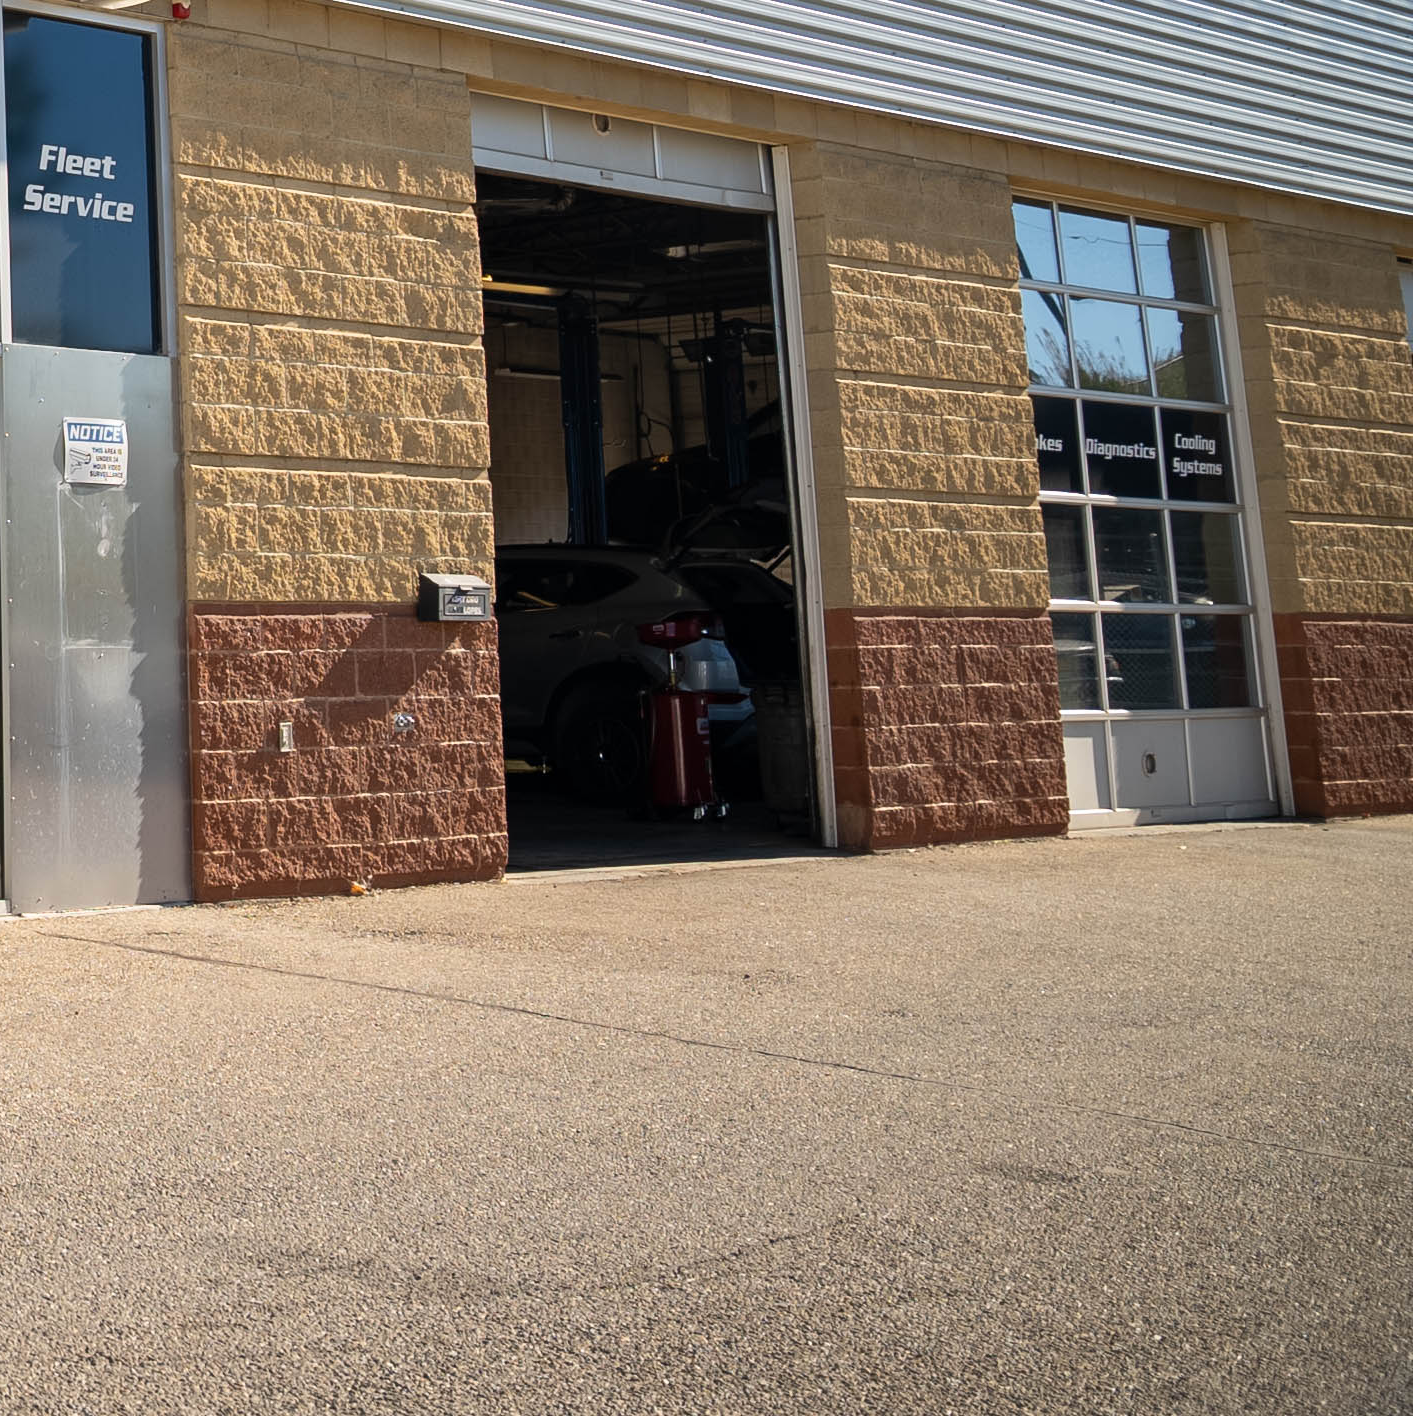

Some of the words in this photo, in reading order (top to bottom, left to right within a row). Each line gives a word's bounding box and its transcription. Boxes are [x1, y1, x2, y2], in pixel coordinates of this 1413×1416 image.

[39, 144, 116, 180] Fleet
[23, 184, 134, 223] Service
[70, 424, 121, 442] NOTICE
[1175, 433, 1215, 455] Cooling
[1085, 438, 1156, 460] Diagnostics
[1173, 457, 1223, 477] Systems
